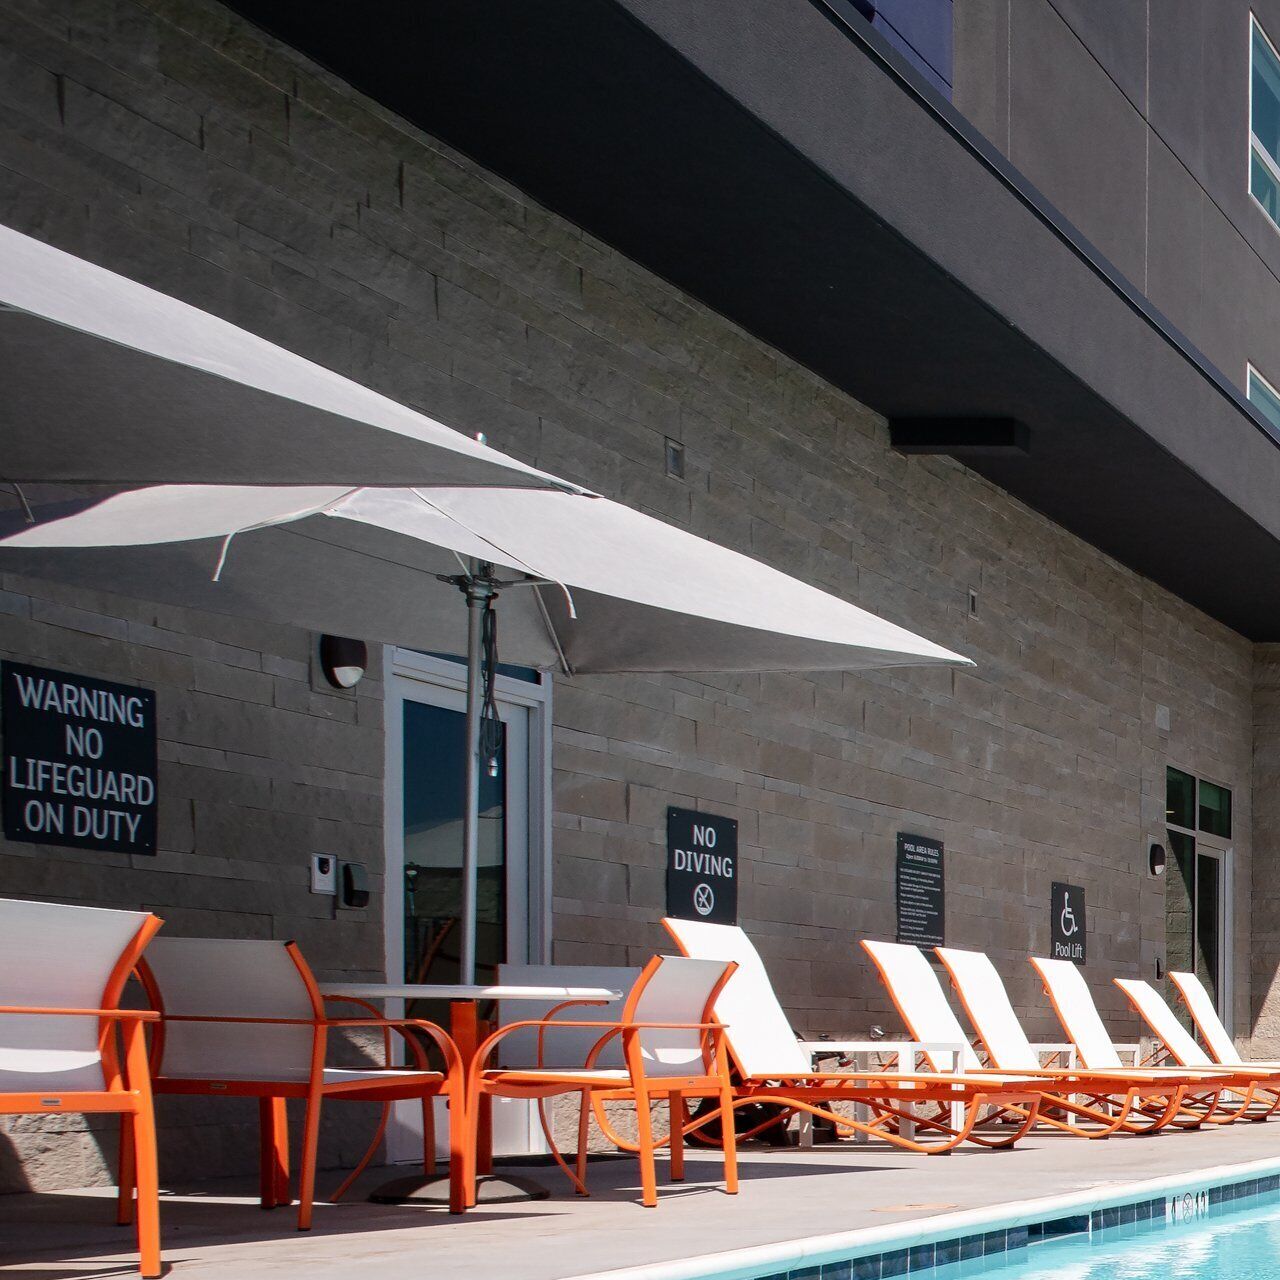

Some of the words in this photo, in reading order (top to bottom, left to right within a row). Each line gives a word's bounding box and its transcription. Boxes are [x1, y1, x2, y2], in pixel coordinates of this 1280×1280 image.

[15, 674, 144, 728] WARNING
[65, 724, 104, 760] NO
[10, 756, 155, 806] LIFEGUARD
[24, 800, 64, 834] ON
[73, 805, 141, 842] DUTY
[693, 824, 716, 848] NO
[674, 849, 733, 878] DIVING
[1055, 942, 1071, 957] Pool
[1072, 943, 1083, 959] Lift
